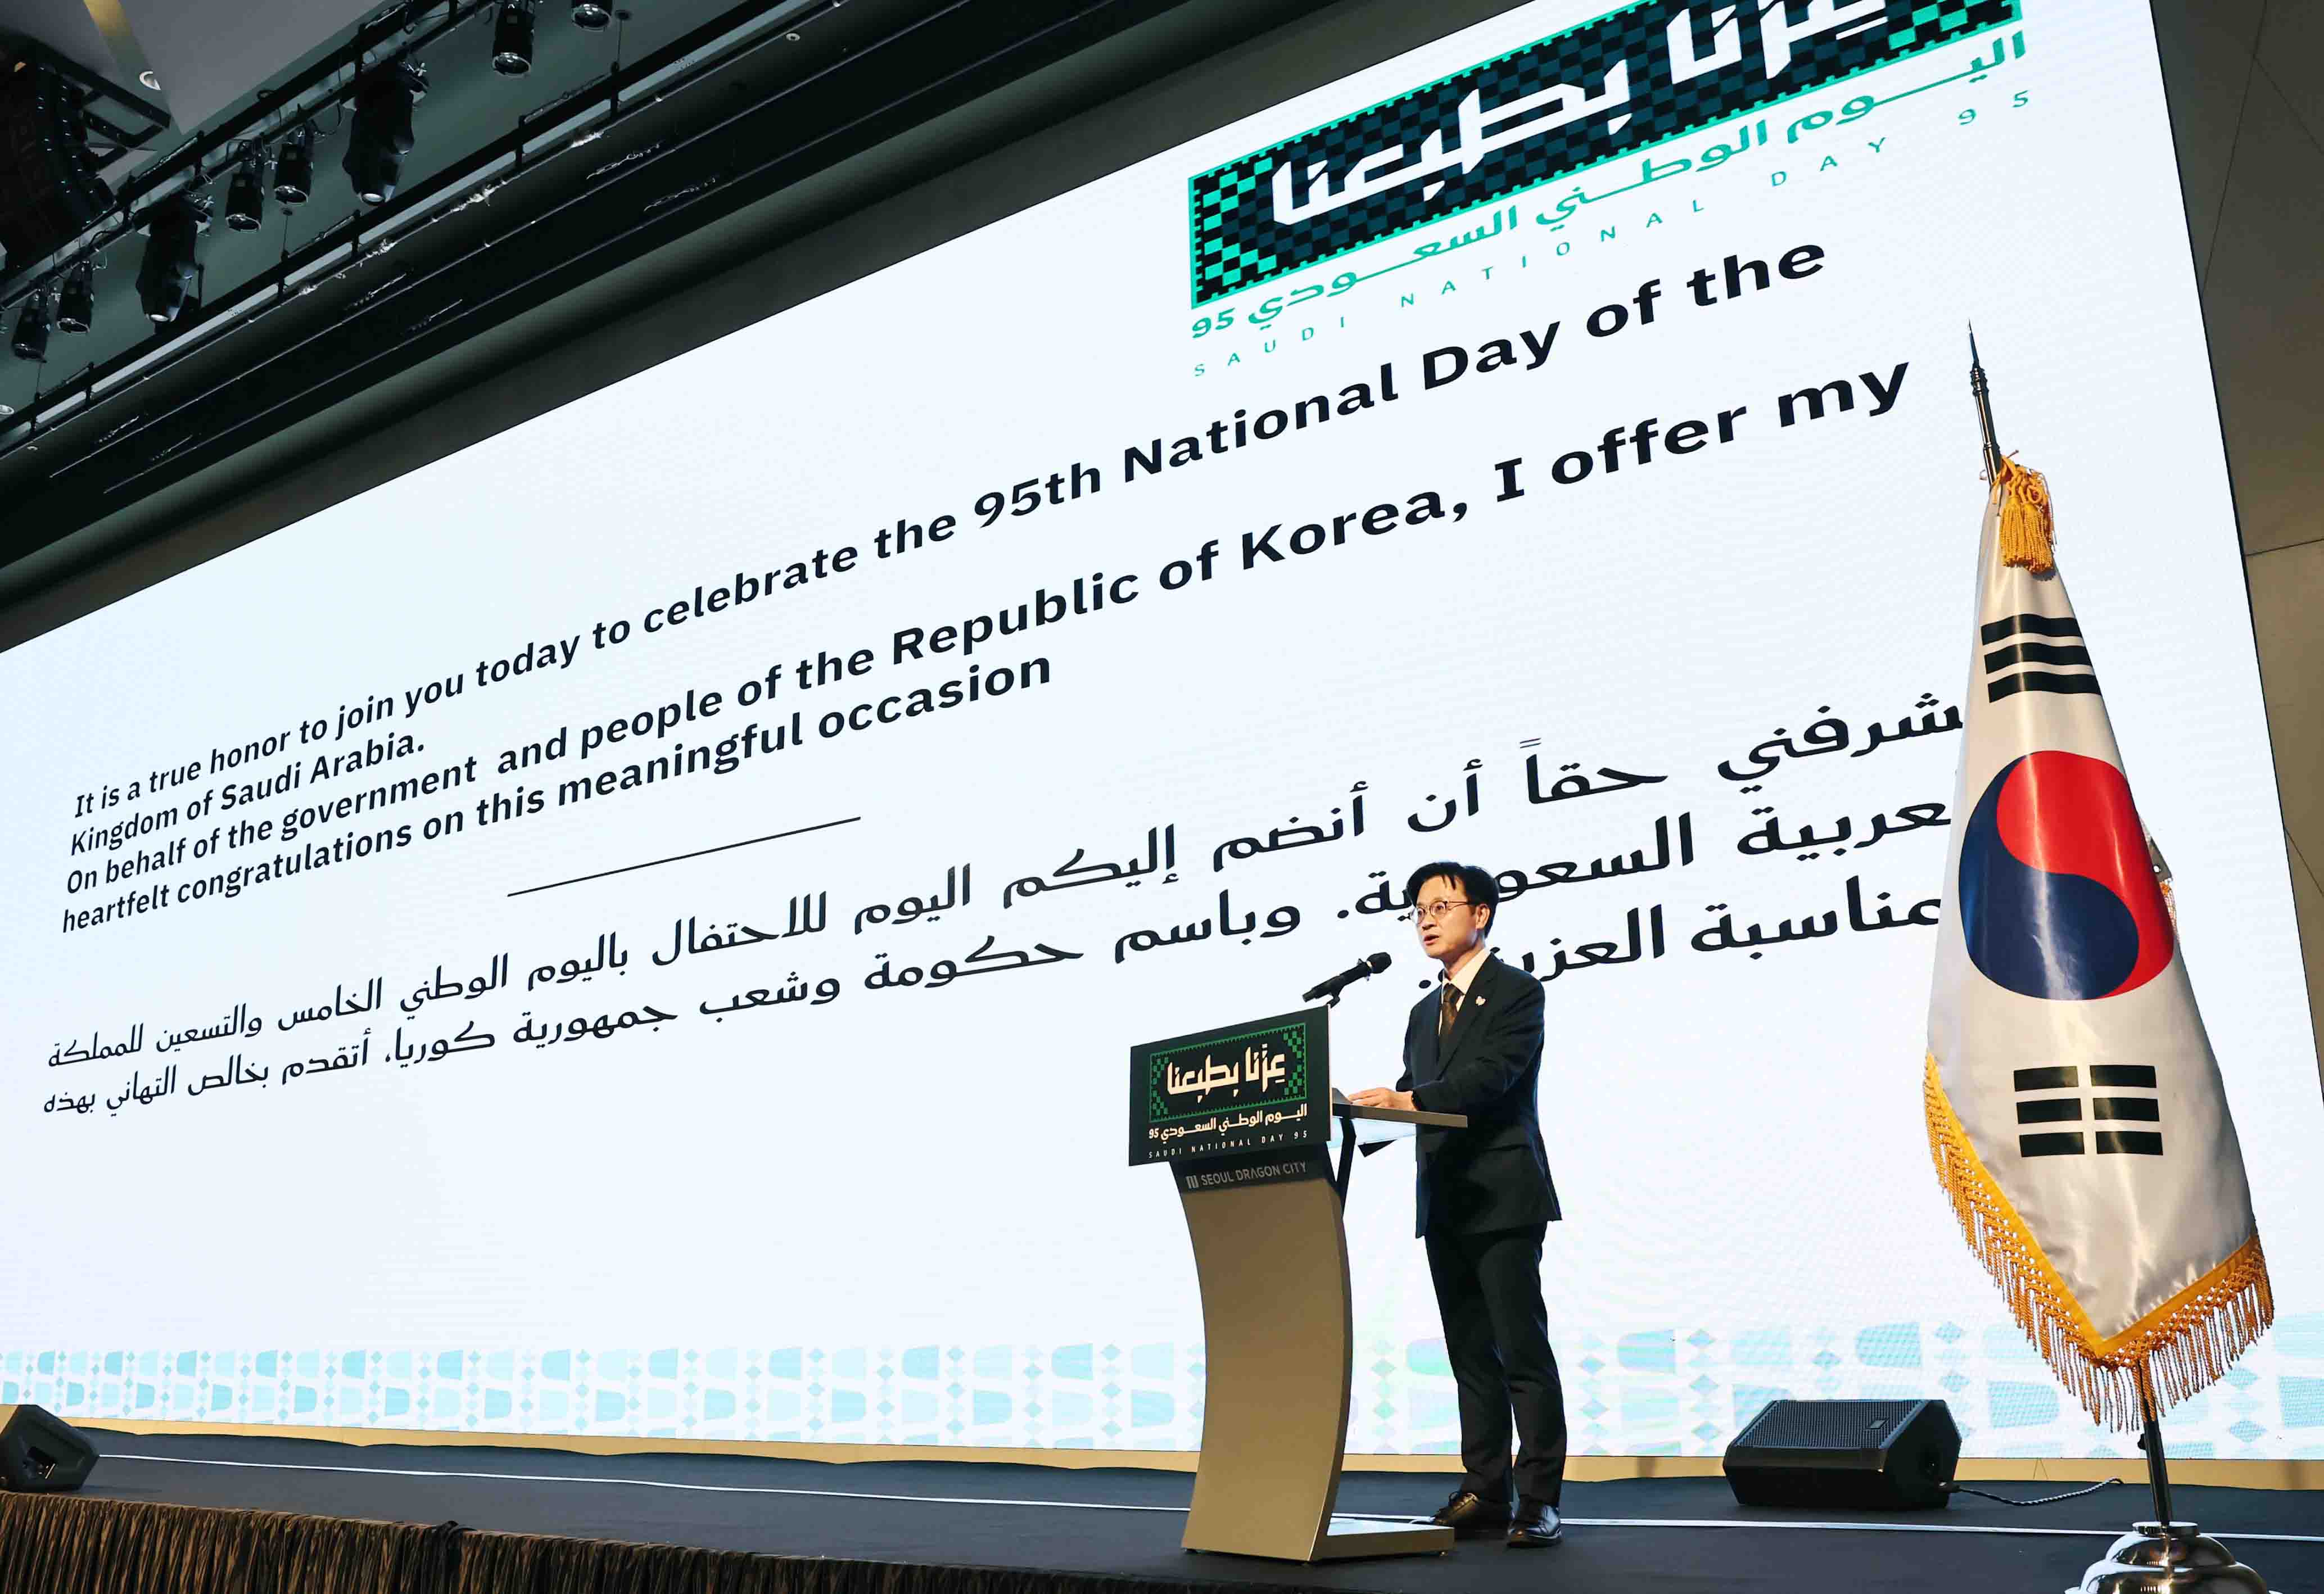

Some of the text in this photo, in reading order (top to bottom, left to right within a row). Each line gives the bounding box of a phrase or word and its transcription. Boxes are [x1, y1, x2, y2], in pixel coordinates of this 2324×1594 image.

[1191, 30, 2026, 338] اليوم الوطني السعودي 95
[1194, 316, 1345, 377] SAUDI
[1400, 200, 1704, 308] NATIONAL
[1771, 137, 1887, 187] DAY
[75, 245, 1824, 818] It is a true honor to join you today to celebrate the 95th National Day of the
[67, 362, 1909, 894] On behalf of the government and people of the Republic of Korea, I offer my
[1718, 693, 1963, 794] شرفني
[63, 658, 1050, 933] heartfelt congratulations on this meaningful occasion
[71, 732, 424, 856] Kingdom of Saudi Arabia.
[1408, 759, 1483, 832] أن
[1213, 781, 1368, 872] أنضم
[1737, 803, 1951, 861] عربية
[1003, 823, 1178, 909] إليكم
[652, 891, 826, 966] للاحتفال
[854, 863, 970, 935] اليوم
[1115, 889, 1300, 964] وباسم
[400, 953, 508, 1020] الوطني
[528, 931, 627, 991] باليوم
[865, 935, 1084, 989] حكومة
[278, 977, 382, 1031] الخامس
[700, 971, 840, 1022] وشعب
[48, 1023, 143, 1067] للمملكة
[156, 1003, 262, 1052] والتسعين
[282, 1028, 371, 1085] أتقدم
[513, 1006, 678, 1049] جمهورية
[43, 1092, 96, 1114] بهذه
[107, 1064, 177, 1117] التهاني
[188, 1054, 268, 1096] بخالص
[1167, 1054, 1239, 1103] بطبعنا
[1149, 1103, 1308, 1144] اليوم الوطني السعودي 95
[1149, 1130, 1308, 1158] SAUDI NATIONAL DAY 95
[1201, 1161, 1306, 1185] SEOUL DRAGON CITY
